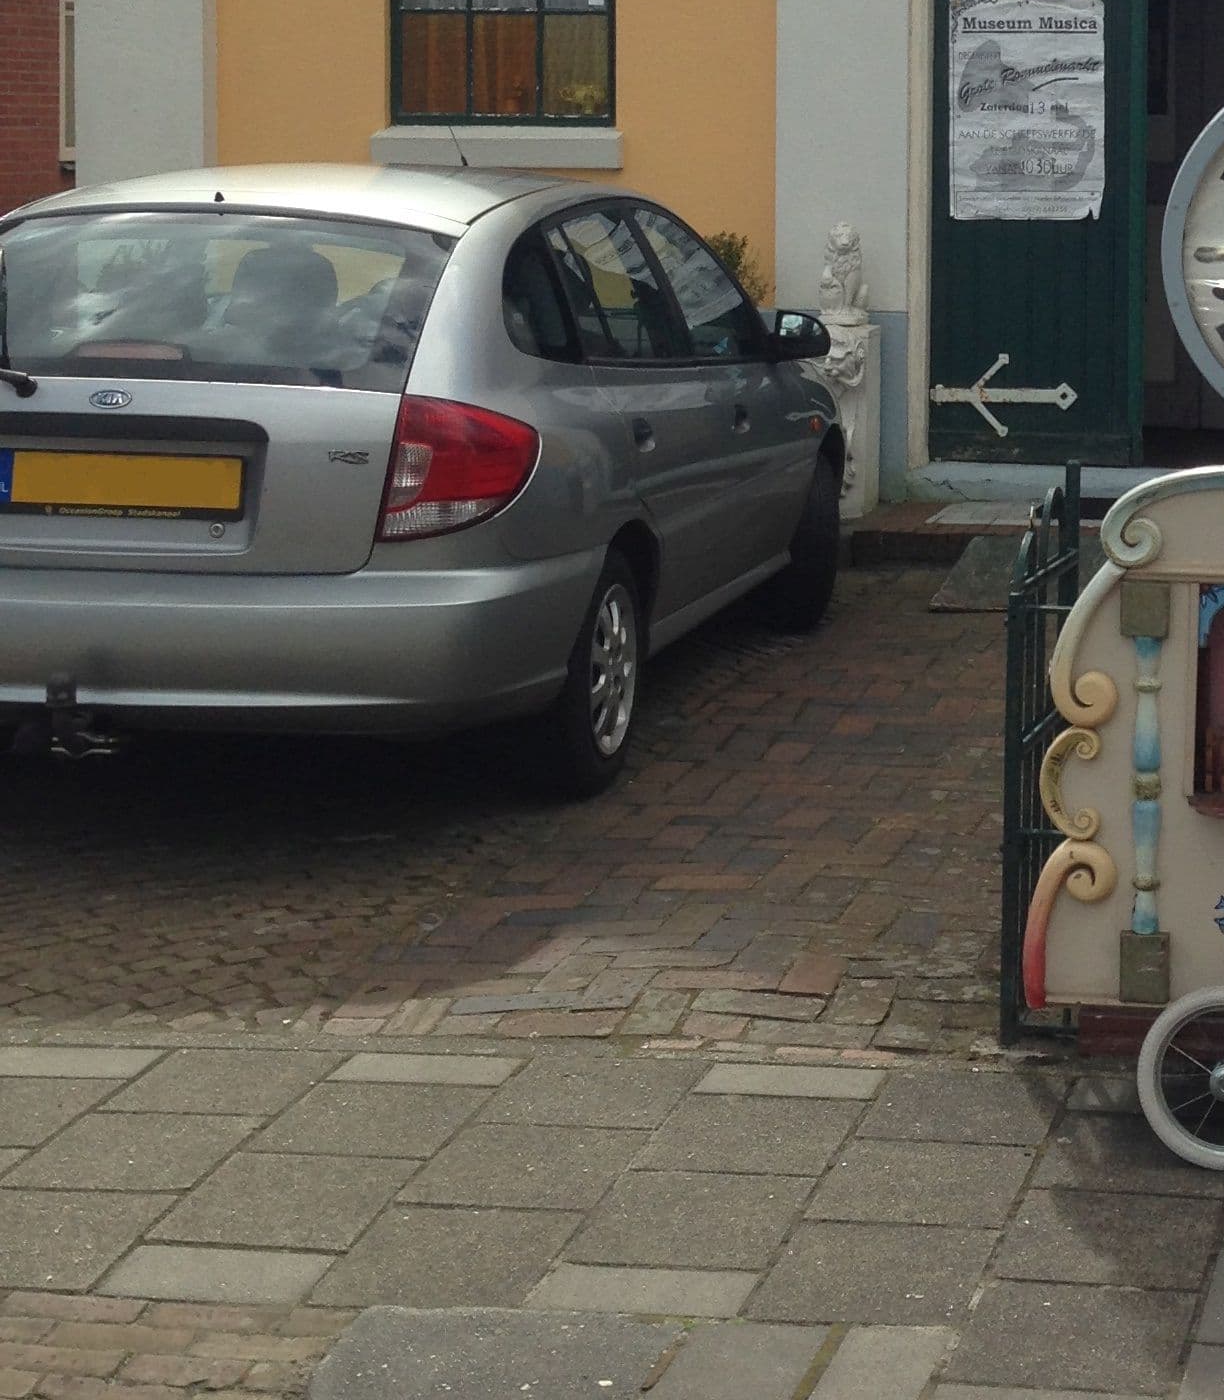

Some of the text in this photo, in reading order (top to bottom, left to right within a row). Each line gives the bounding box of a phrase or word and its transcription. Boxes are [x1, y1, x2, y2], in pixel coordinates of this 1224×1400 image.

[963, 16, 1097, 30] Museum Musica
[97, 392, 124, 405] KIA
